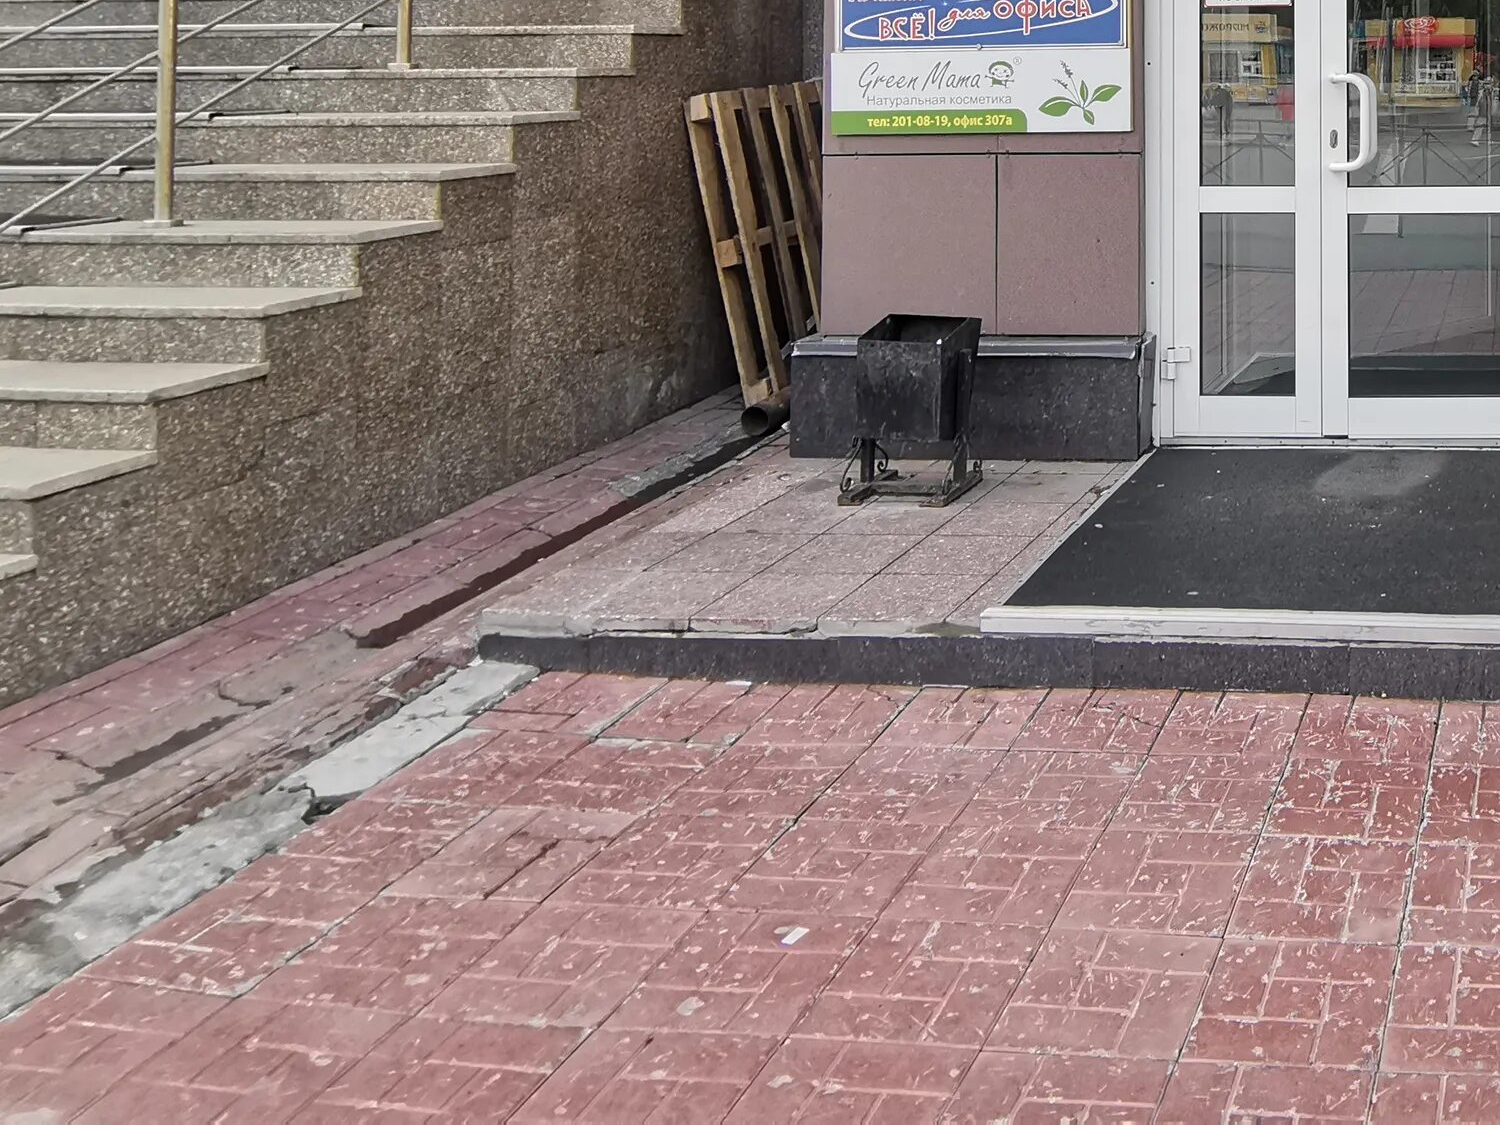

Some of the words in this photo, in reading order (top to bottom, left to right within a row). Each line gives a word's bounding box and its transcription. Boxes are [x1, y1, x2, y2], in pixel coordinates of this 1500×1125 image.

[858, 61, 917, 98] Green
[921, 60, 981, 92] Mama
[866, 94, 946, 108] Натуральная
[949, 93, 1013, 105] косметика
[867, 118, 891, 127] тел:
[892, 116, 952, 129] 201-08-19,
[953, 115, 983, 130] офис
[985, 115, 1013, 126] 307а
